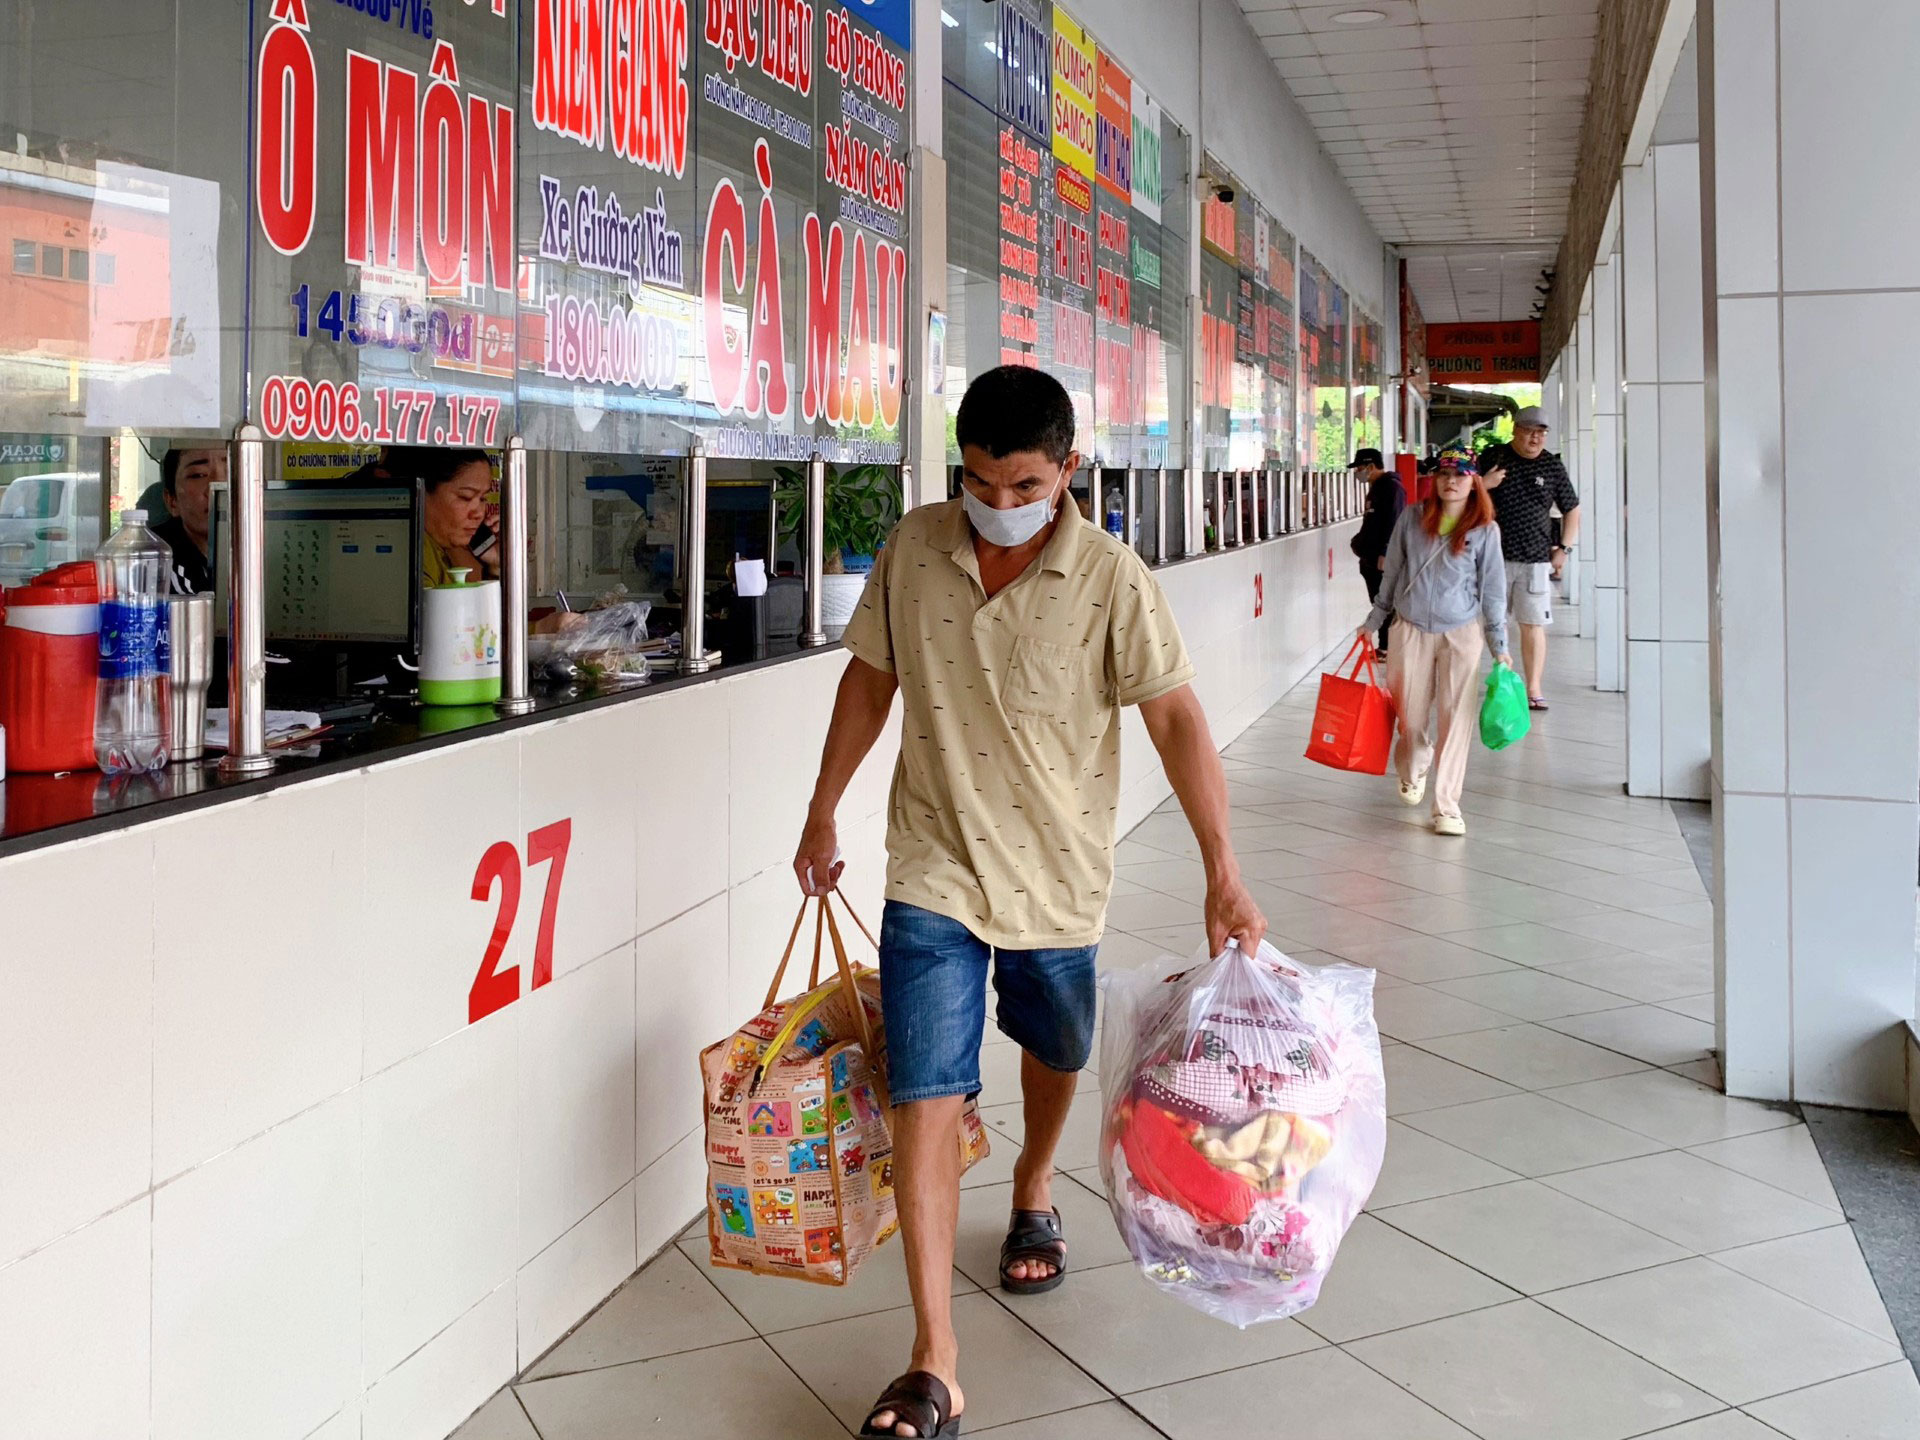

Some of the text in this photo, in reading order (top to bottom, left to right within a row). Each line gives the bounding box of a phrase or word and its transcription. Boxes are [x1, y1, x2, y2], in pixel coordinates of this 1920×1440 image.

[609, 0, 689, 180] GIANG
[825, 7, 905, 112] HỘ PHÒNG
[1055, 31, 1094, 100] KUMHO
[257, 0, 514, 293] Ô MÔN
[1055, 92, 1094, 156] SAMCO
[825, 116, 905, 215] NĂM CĂN
[540, 174, 683, 300] Xe Giường Nằm
[704, 137, 789, 420] CÀ
[803, 211, 905, 431] MAU
[545, 293, 678, 390] 180.000Đ
[1492, 356, 1538, 372] TRANG
[260, 375, 501, 446] 0906.177.177
[287, 452, 296, 467] CÓ
[328, 452, 349, 467] TRÌNH
[468, 817, 572, 1025] 27
[709, 1102, 738, 1116] HAPPY
[801, 1096, 821, 1109] LOVE
[711, 1142, 740, 1156] HAPPY
[765, 1245, 797, 1257] HAPPY
